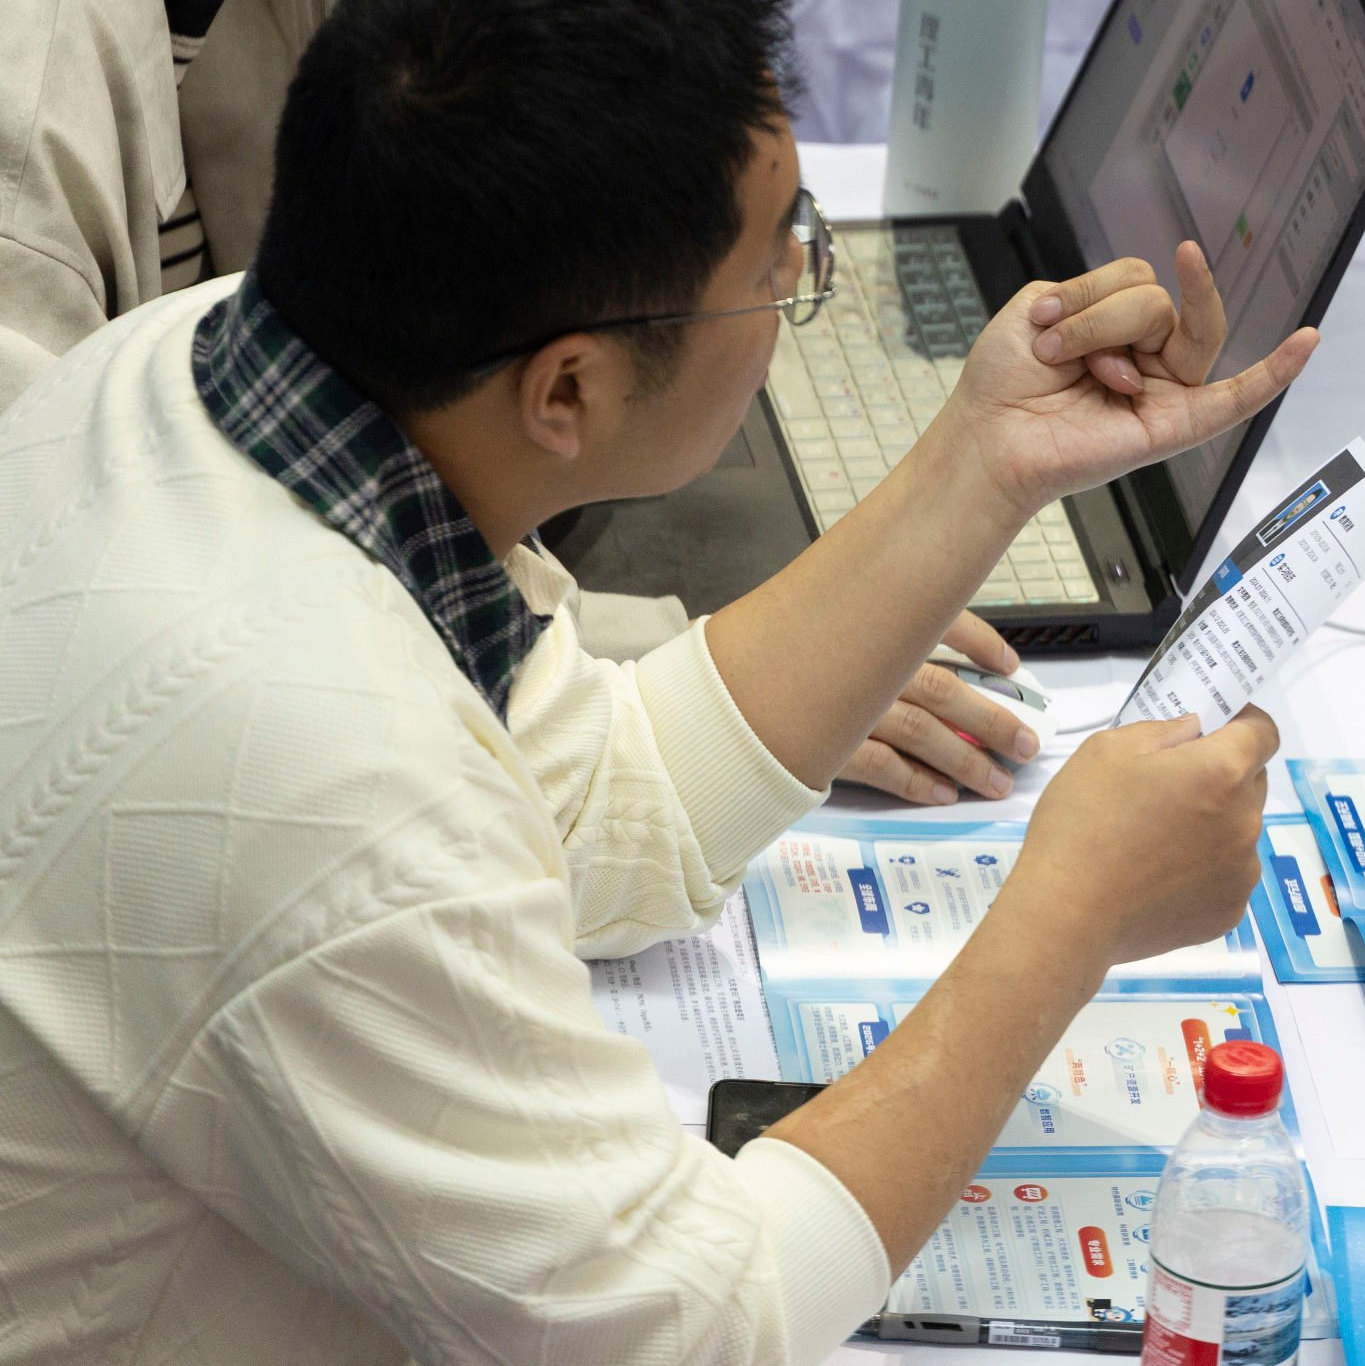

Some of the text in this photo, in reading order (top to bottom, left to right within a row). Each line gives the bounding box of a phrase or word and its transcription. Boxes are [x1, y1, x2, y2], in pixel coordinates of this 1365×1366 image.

[1039, 1108, 1055, 1134] 数智应用
[1087, 1239, 1105, 1267] 专业需求
